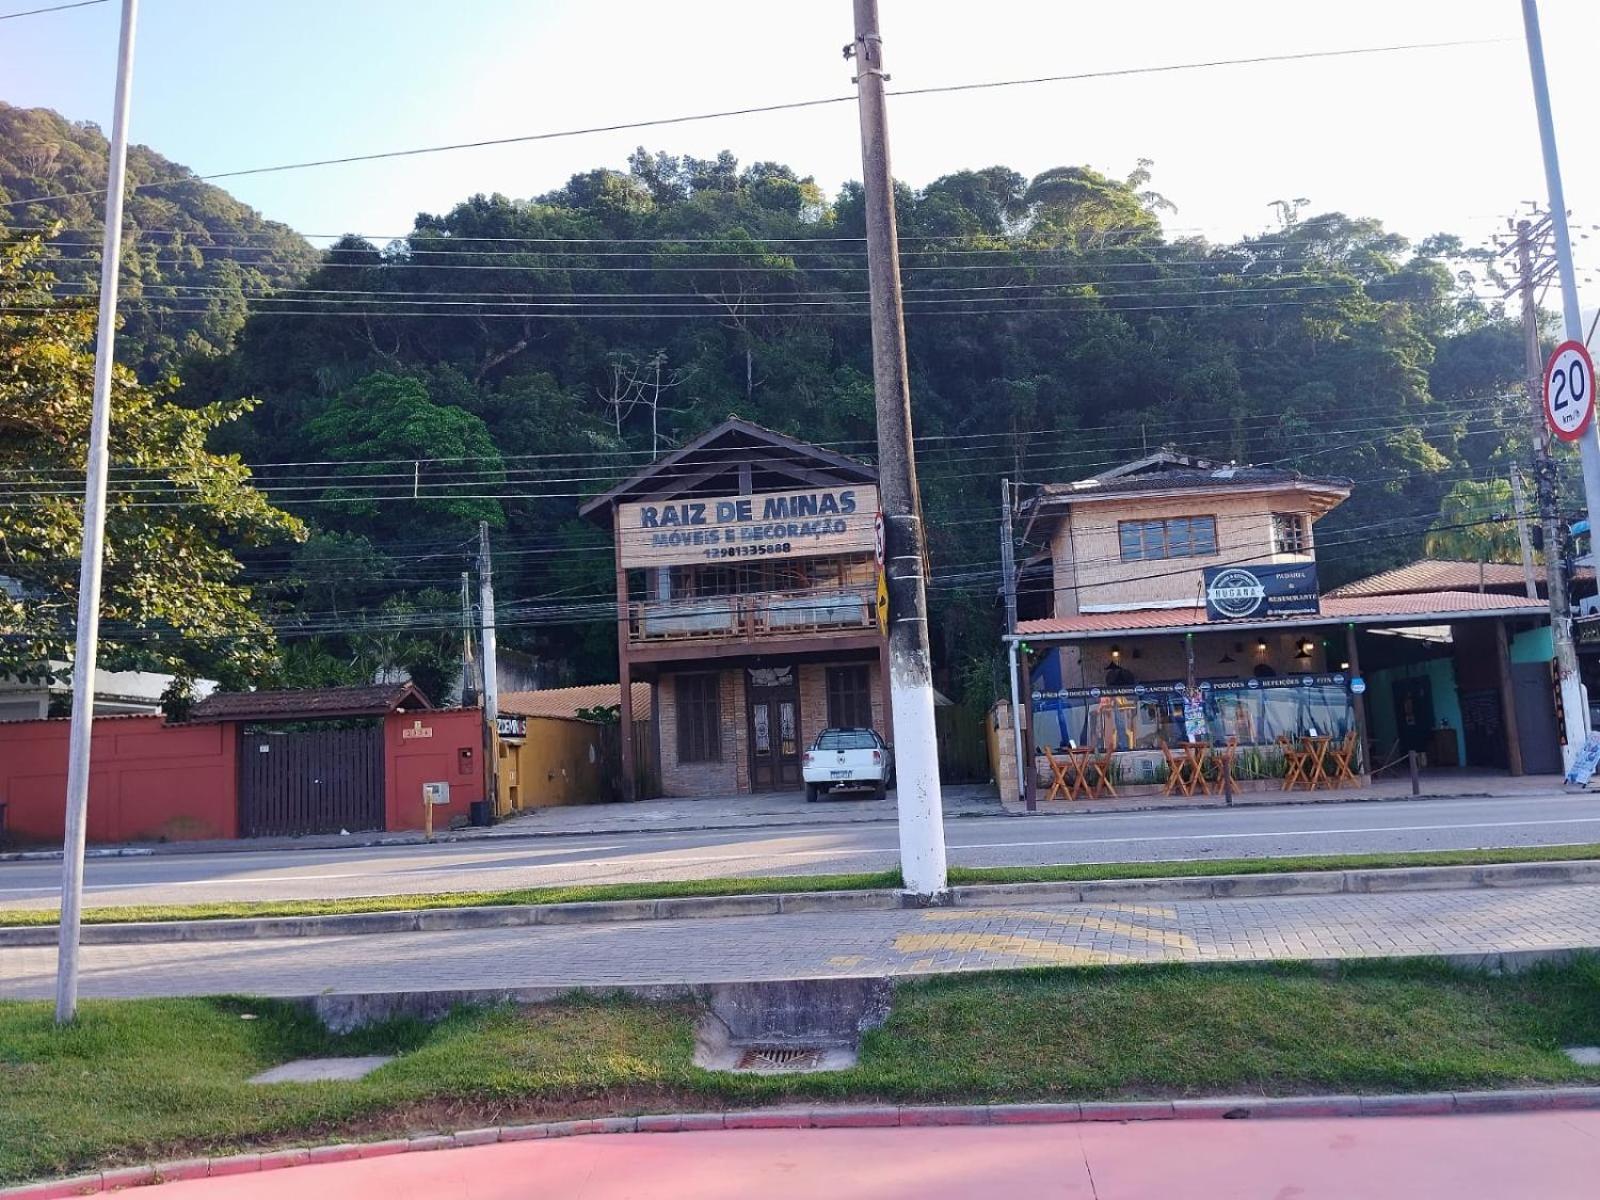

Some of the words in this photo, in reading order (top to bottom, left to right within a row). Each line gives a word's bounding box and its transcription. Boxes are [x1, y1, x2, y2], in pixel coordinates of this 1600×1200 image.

[1552, 360, 1585, 412] 20
[641, 503, 706, 528] RAIZ
[716, 500, 753, 523] DE
[763, 490, 856, 521] MINAS
[652, 529, 720, 548] MÓVEIS
[725, 528, 735, 543] E
[740, 519, 847, 541] DECORAÇÃO
[1213, 681, 1245, 690] PORÇÕES
[1262, 678, 1300, 688] REFEIÇÕES
